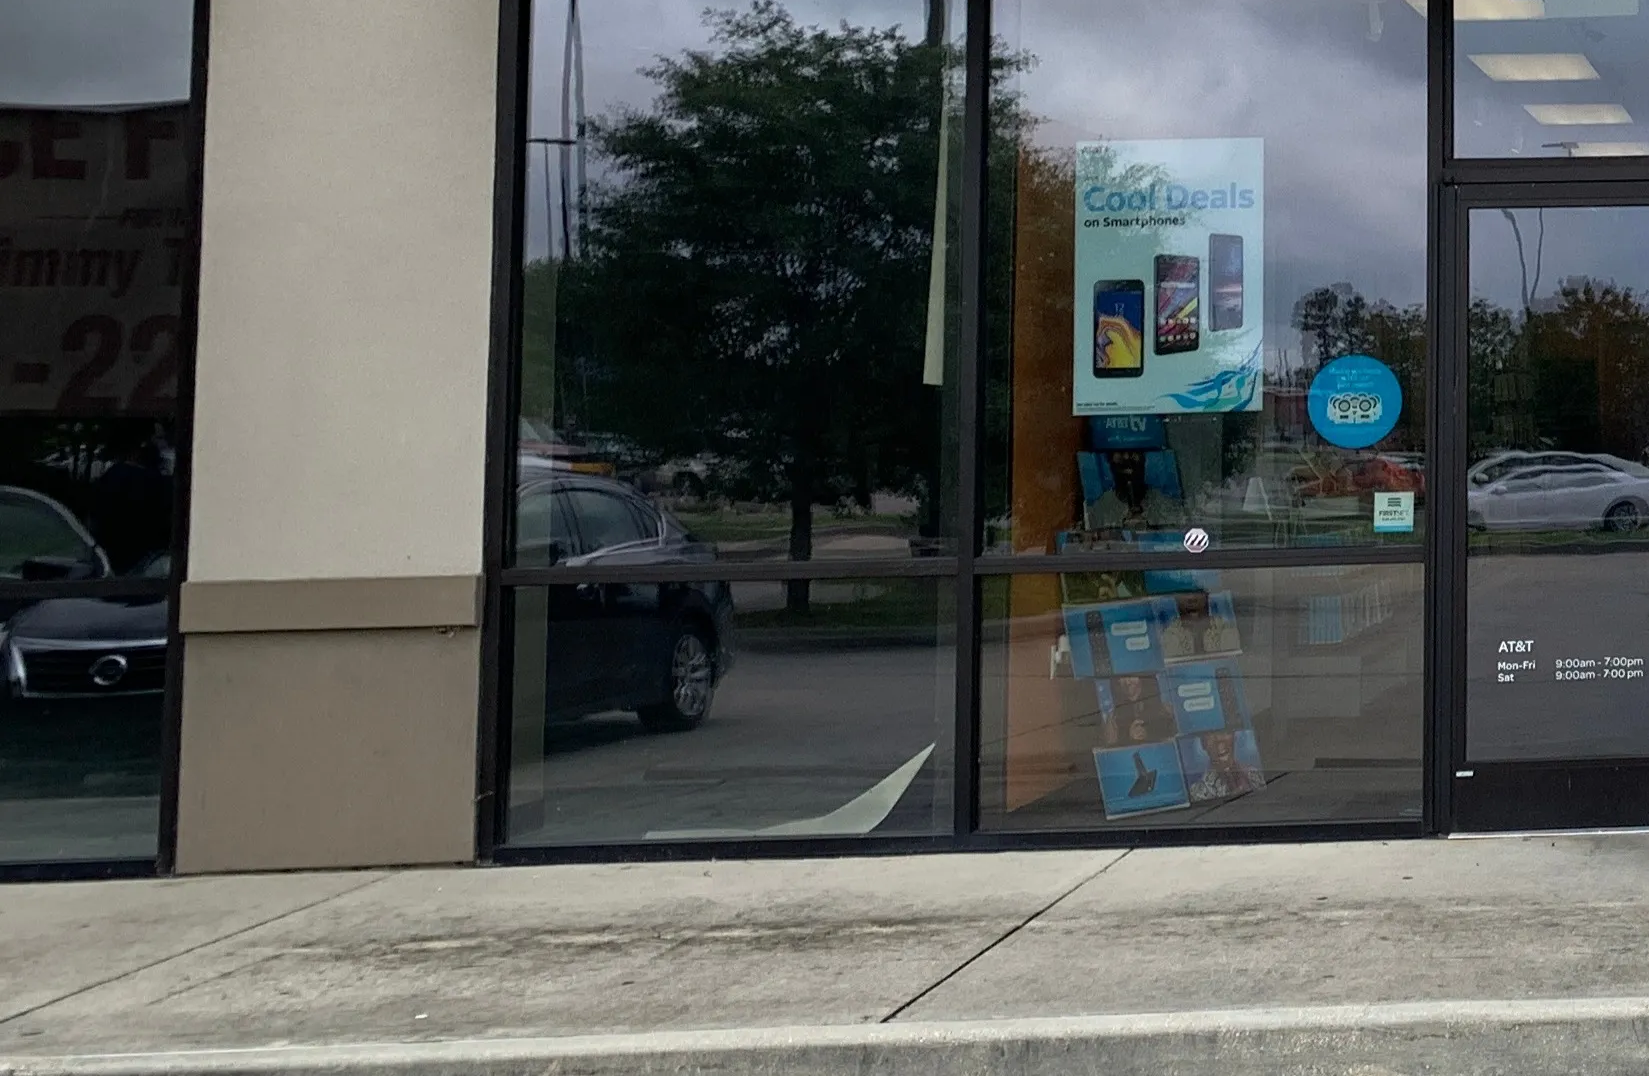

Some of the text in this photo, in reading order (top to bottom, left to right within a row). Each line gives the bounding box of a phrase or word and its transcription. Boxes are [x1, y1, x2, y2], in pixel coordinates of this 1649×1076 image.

[1083, 181, 1255, 212] Cool Deals
[1083, 216, 1186, 229] on Smartphones
[1498, 640, 1534, 653] AT&T
[1497, 660, 1536, 671] Mon-Fri
[1555, 658, 1596, 668] 9:00am
[1604, 657, 1644, 668] 7:00pm
[1497, 673, 1515, 682] Sat
[1555, 670, 1596, 681] 9:00am
